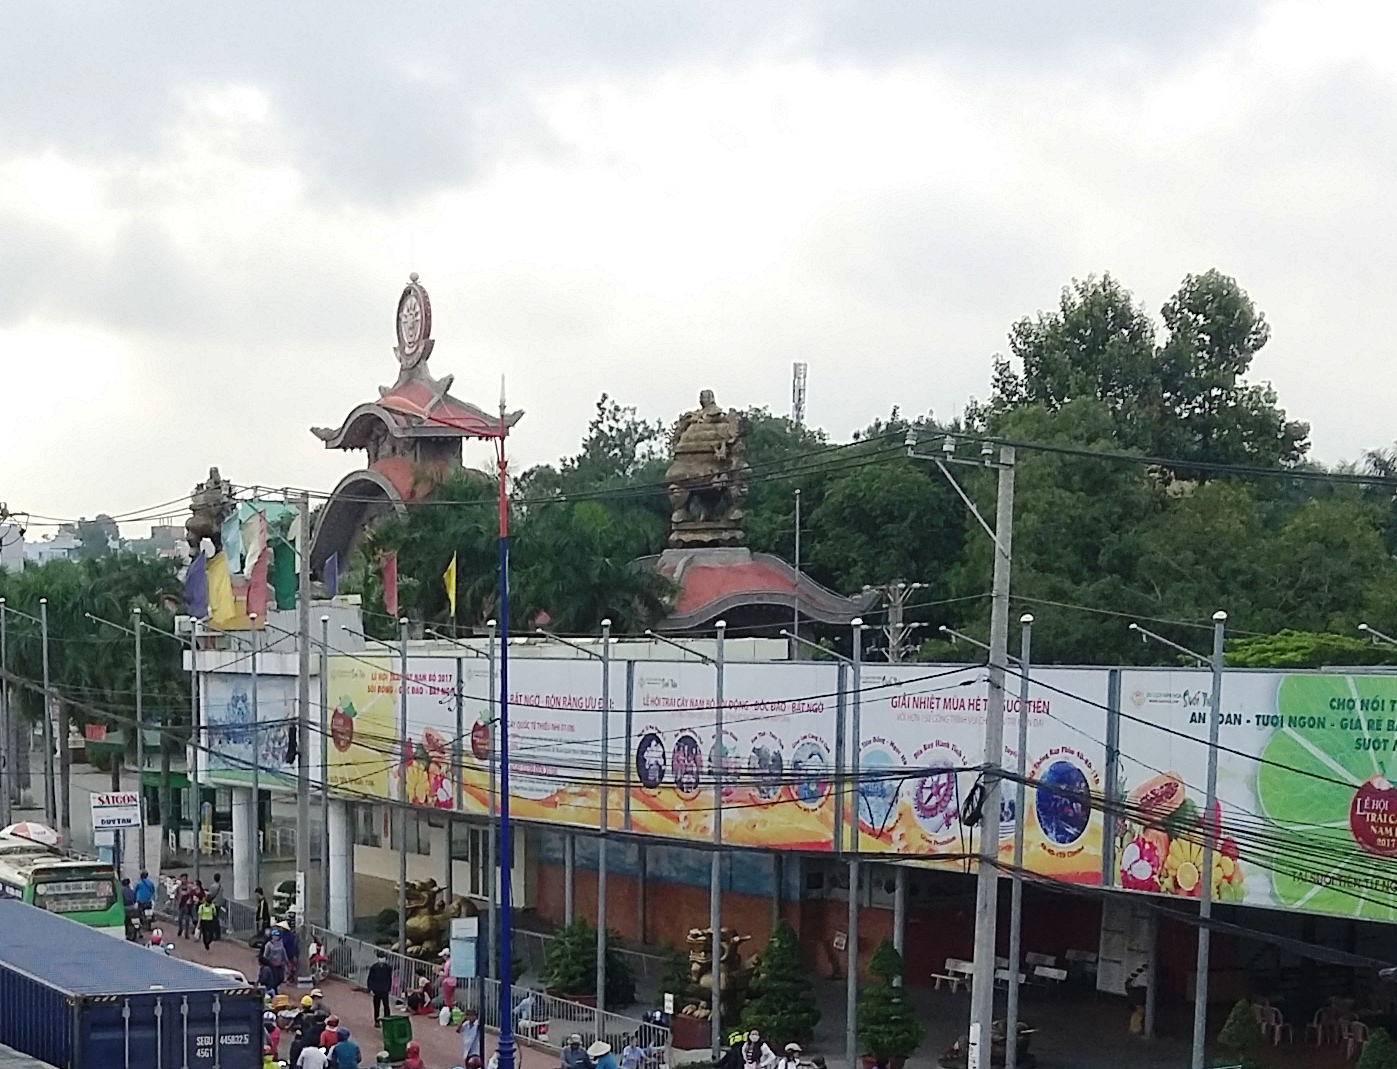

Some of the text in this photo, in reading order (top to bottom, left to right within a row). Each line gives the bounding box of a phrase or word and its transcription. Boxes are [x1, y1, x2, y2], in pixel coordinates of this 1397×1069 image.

[1189, 711, 1206, 724] AN
[1288, 714, 1326, 729] NGON
[97, 794, 138, 805] SAIGON
[1370, 825, 1394, 837] NAM
[1376, 837, 1397, 848] 2017
[196, 1036, 214, 1046] SEGU
